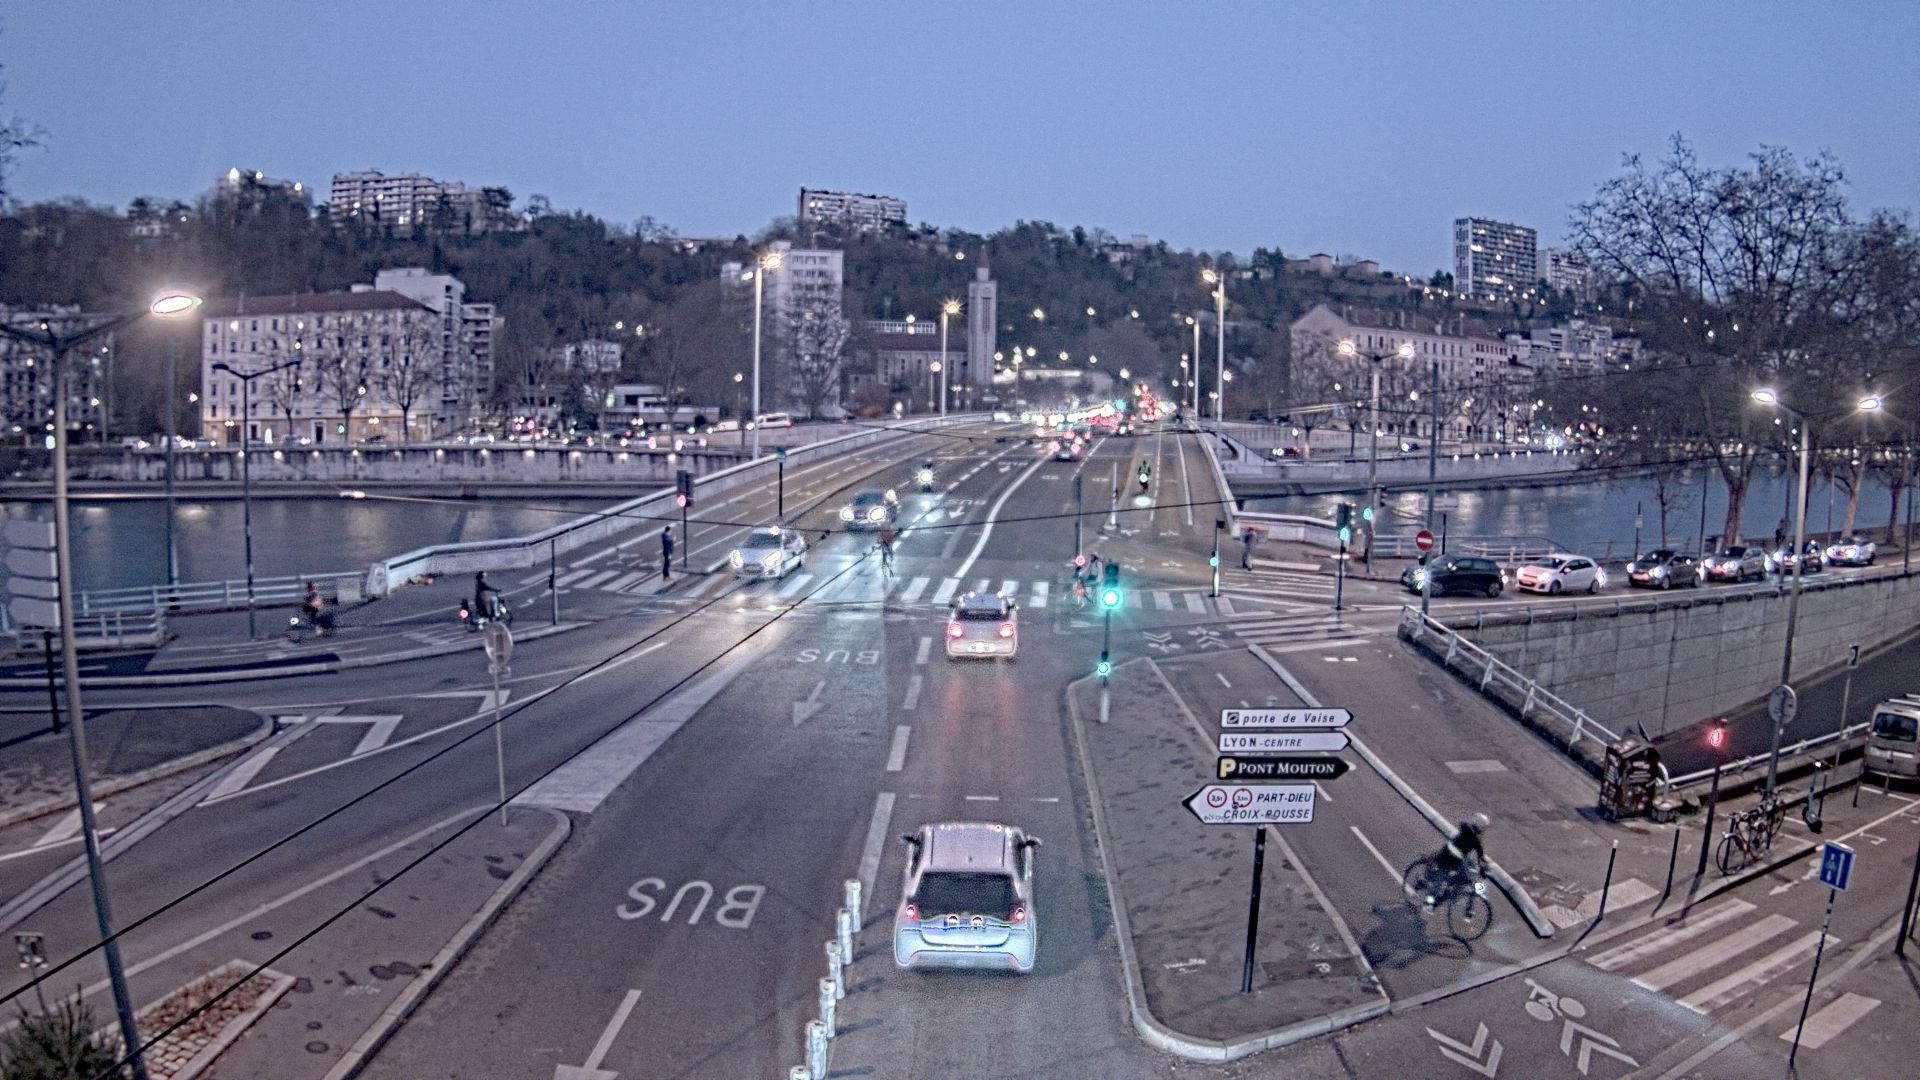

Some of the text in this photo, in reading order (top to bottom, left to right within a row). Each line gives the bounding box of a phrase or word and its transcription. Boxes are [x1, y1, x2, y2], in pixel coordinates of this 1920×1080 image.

[796, 649, 880, 665] BUS
[1243, 713, 1335, 725] porte de Vaise
[1220, 758, 1335, 778] P PONT MOUTON
[1256, 793, 1312, 802] PART-DIEU
[1223, 809, 1310, 819] CROIX-ROUSSE
[616, 877, 767, 929] BUS
